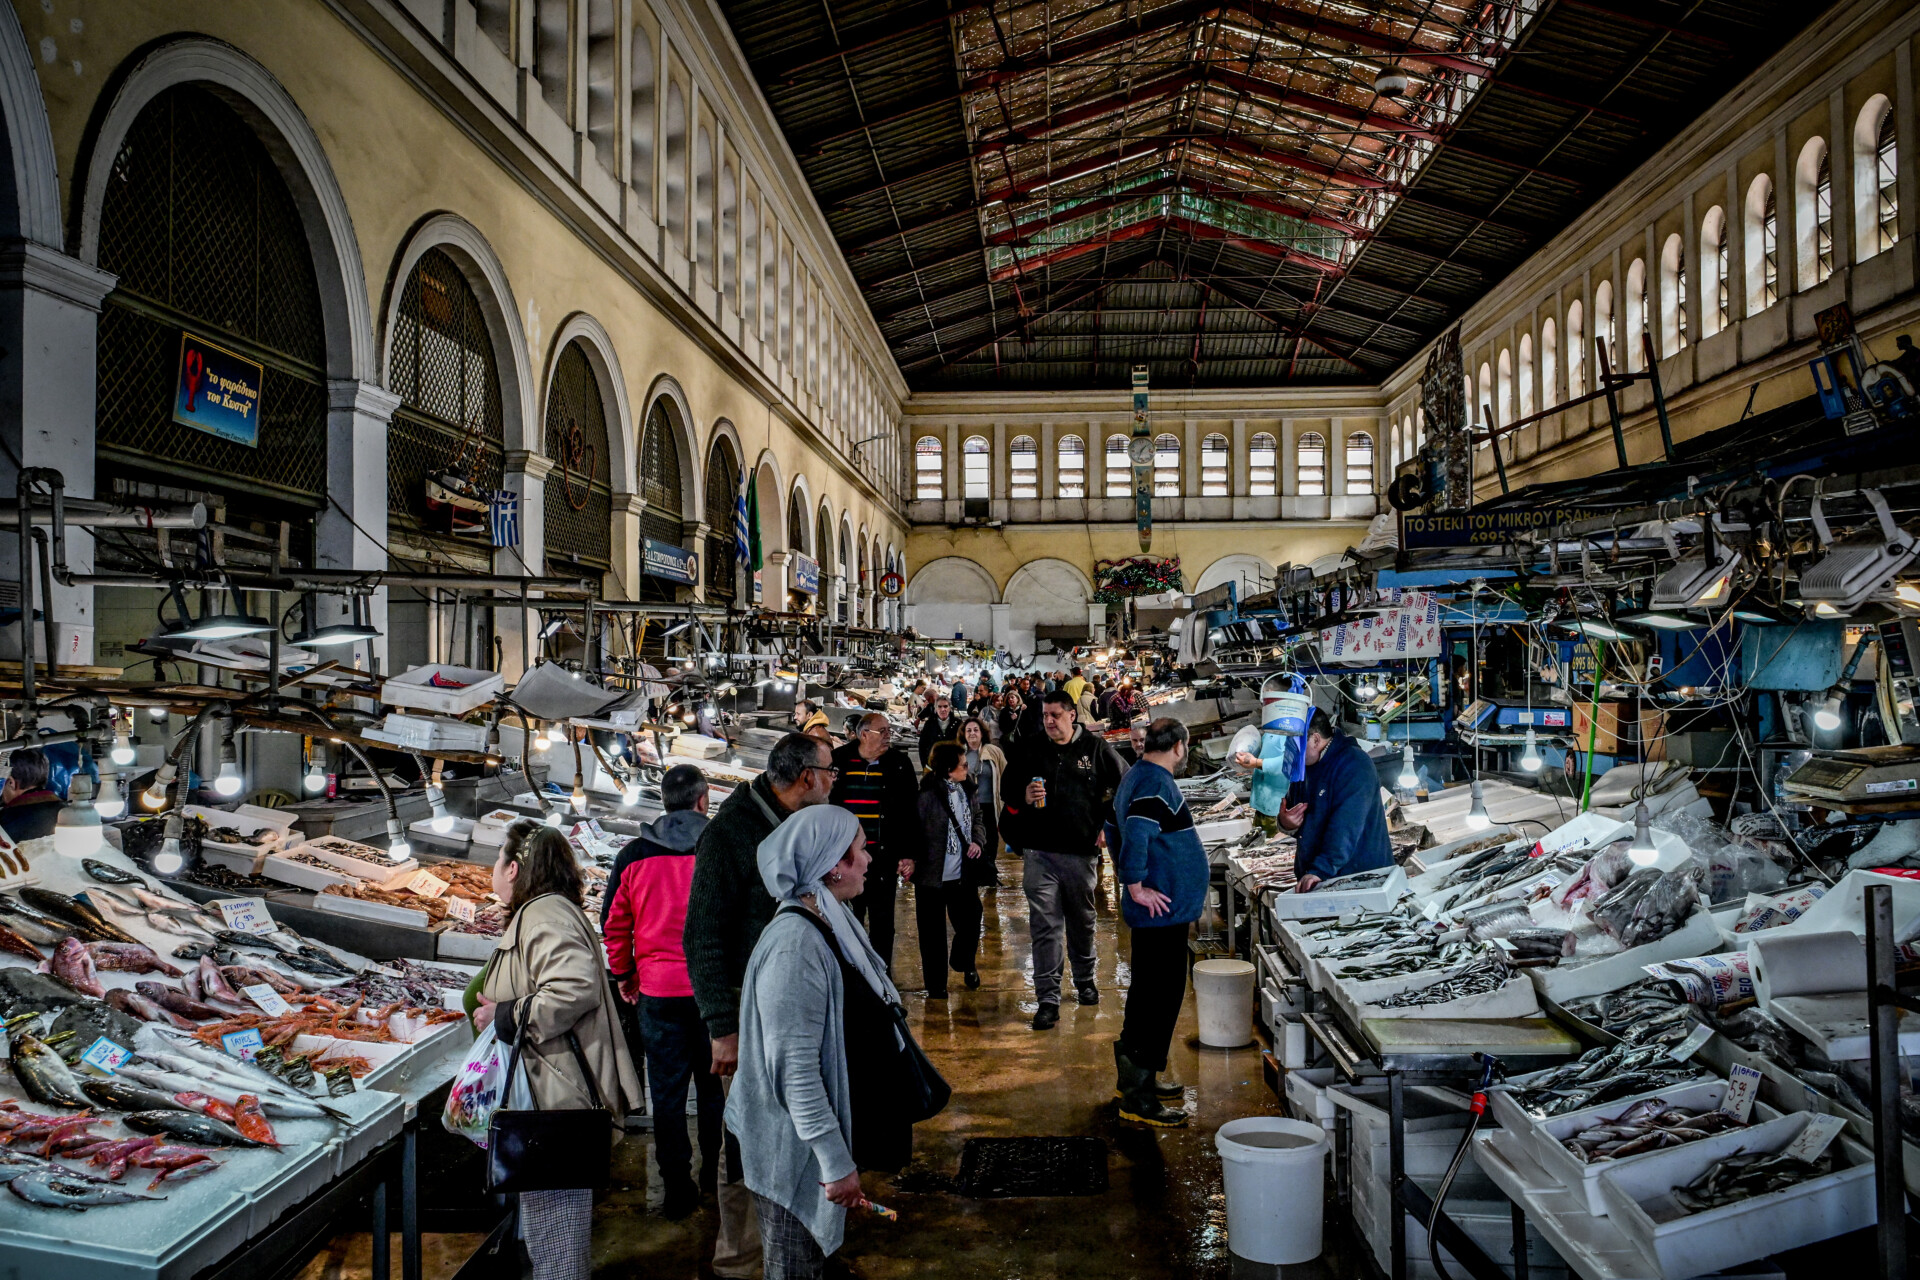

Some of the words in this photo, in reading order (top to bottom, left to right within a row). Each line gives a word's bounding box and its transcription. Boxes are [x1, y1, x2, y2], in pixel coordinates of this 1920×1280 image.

[206, 391, 221, 405] του
[219, 377, 258, 401] ψαράδικο
[1406, 518, 1426, 534] TO
[1427, 515, 1465, 533] STEKI
[1466, 513, 1496, 530] TOY
[1498, 510, 1552, 530] MIKROY
[1469, 530, 1508, 544] 6995
